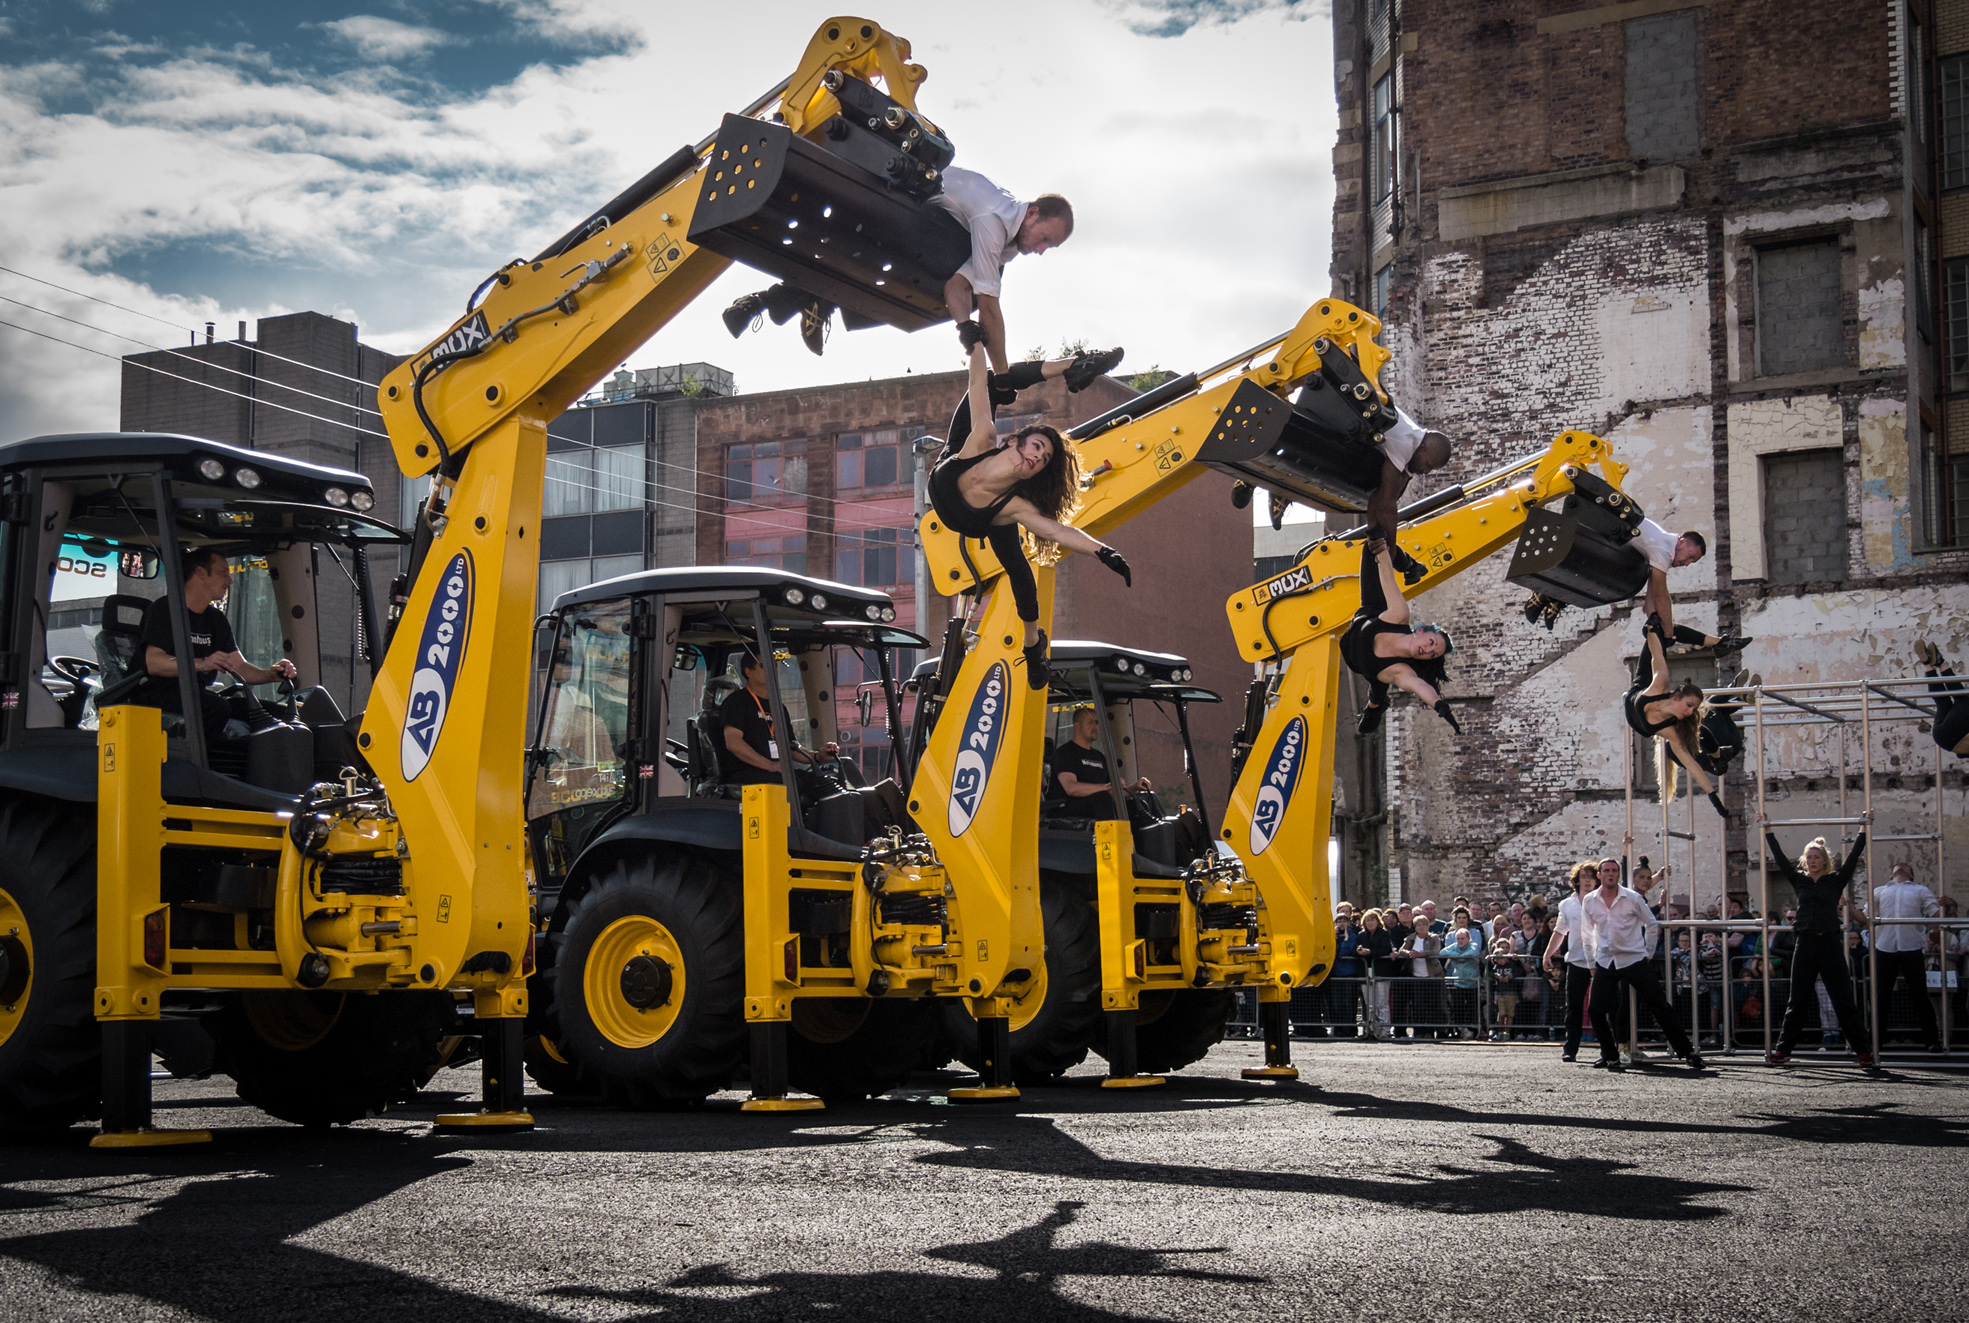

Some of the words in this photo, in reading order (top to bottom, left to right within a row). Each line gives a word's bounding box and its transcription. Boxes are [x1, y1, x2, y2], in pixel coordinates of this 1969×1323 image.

[1269, 568, 1308, 597] 3CX
[407, 690, 440, 757] AB
[427, 575, 464, 668] 2000
[454, 557, 465, 575] LTD
[953, 767, 981, 819] AB
[969, 679, 1001, 751] 2000
[994, 665, 1002, 680] LTD
[1254, 799, 1280, 842] AB
[1270, 730, 1300, 788] 2000
[1293, 719, 1301, 731] LTD
